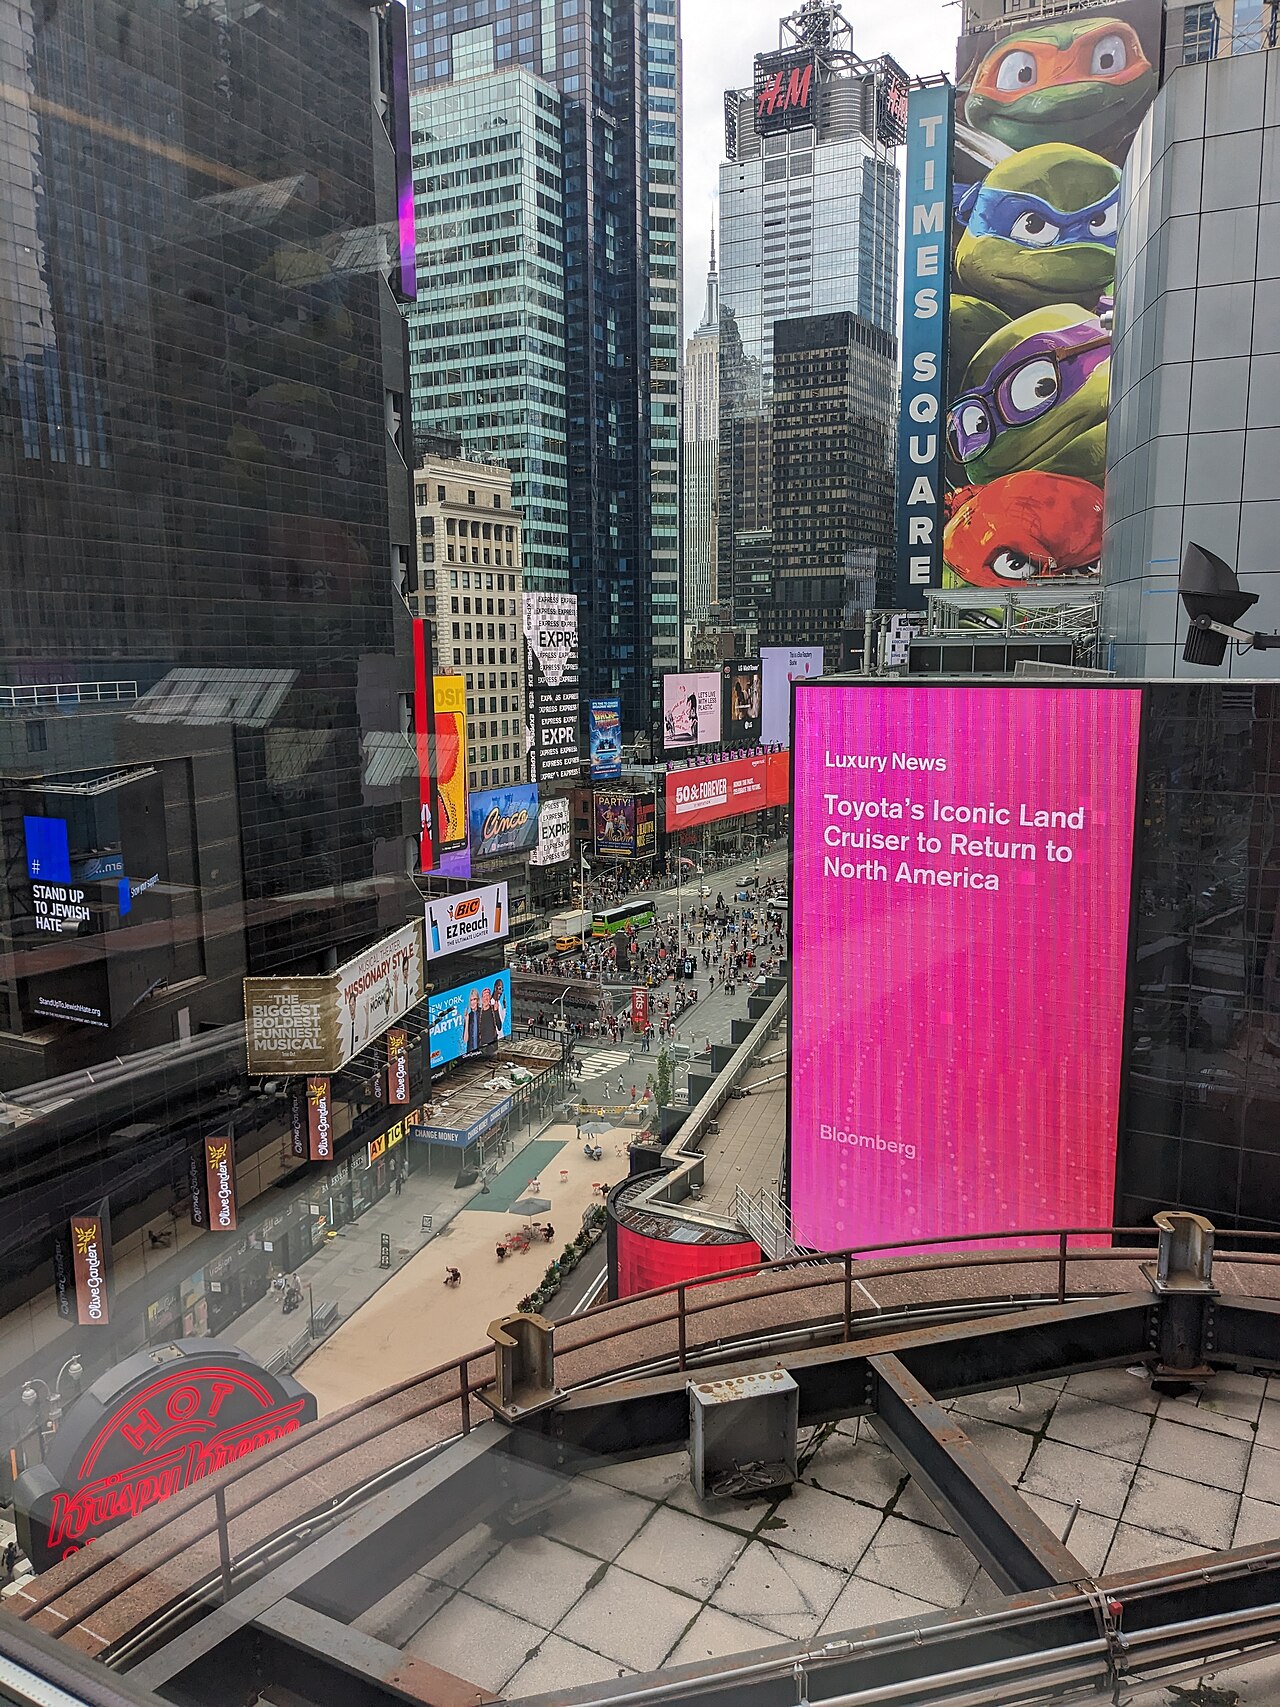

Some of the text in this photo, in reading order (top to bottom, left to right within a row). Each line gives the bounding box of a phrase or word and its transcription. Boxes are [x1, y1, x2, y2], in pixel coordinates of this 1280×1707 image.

[757, 64, 812, 117] H&M
[909, 115, 943, 585] TIMES SQUARE
[825, 751, 947, 773] Luxury News
[599, 797, 632, 807] PARTY!
[824, 793, 1085, 830] Toyota’s Iconic Land
[483, 807, 529, 841] Cinco
[824, 825, 1073, 863] Cruiser to Return to
[824, 856, 1000, 891] North America
[33, 885, 84, 904] STAND UP
[34, 900, 90, 921] TO JEWISH
[35, 916, 63, 933] HATE
[446, 917, 488, 939] EZ Reach
[454, 935, 473, 944] ULTIMATE
[473, 930, 488, 939] LIGHTER
[344, 957, 392, 1004] MISSIONARY
[392, 943, 414, 970] STYLE
[358, 939, 401, 975] MUSICAL THEATER
[39, 996, 101, 1017] StandUpToJewishHate.org
[429, 1015, 462, 1037] PARTY!
[317, 1097, 330, 1156] Olive Garden
[415, 1129, 459, 1142] CHANGE MONEY
[820, 1123, 917, 1159] Bloomberg
[217, 1159, 232, 1226] Olive Garden
[86, 1242, 103, 1319] Olive Garden
[121, 1383, 234, 1449] HOT
